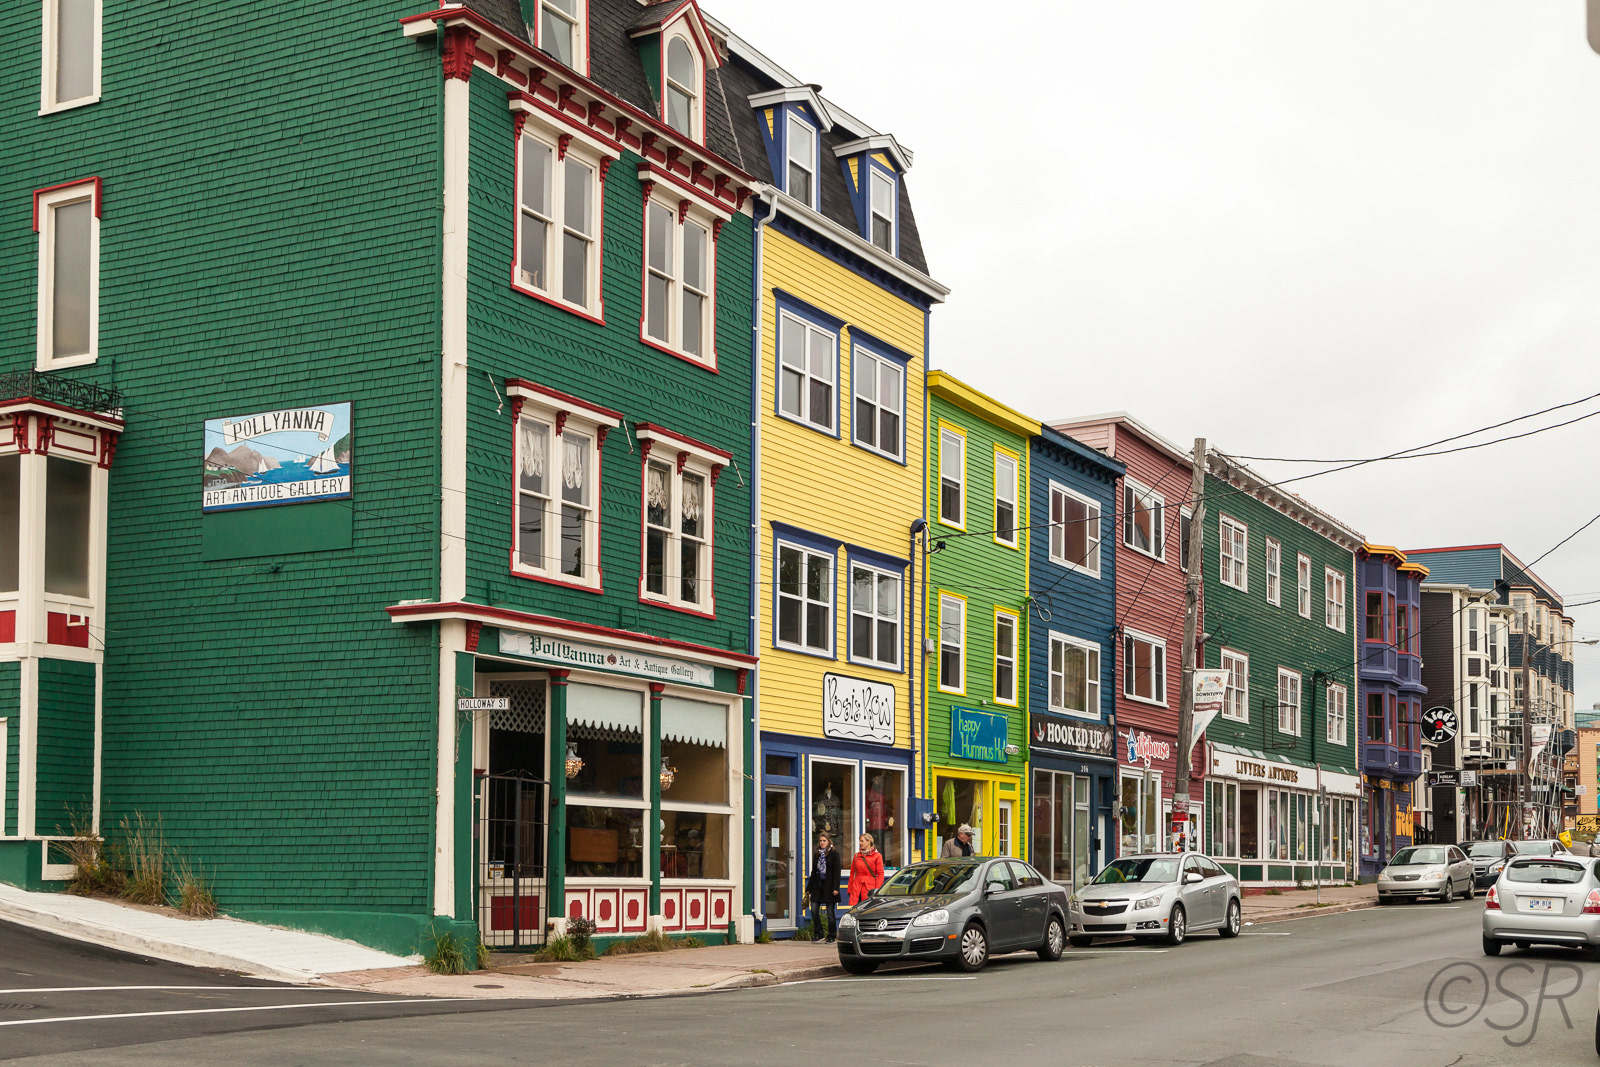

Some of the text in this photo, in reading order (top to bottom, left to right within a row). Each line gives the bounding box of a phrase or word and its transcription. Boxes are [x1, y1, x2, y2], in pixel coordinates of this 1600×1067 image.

[233, 411, 325, 441] POLLYANNA
[206, 491, 227, 505] ART
[232, 485, 283, 502] ANTIQUE
[289, 478, 344, 496] GALLERY
[530, 635, 694, 680] Pollyanna Art & Antique Gallery
[460, 699, 506, 708] HOLLOWAY ST
[959, 709, 981, 741] happy
[1047, 723, 1102, 749] HOOKED UP
